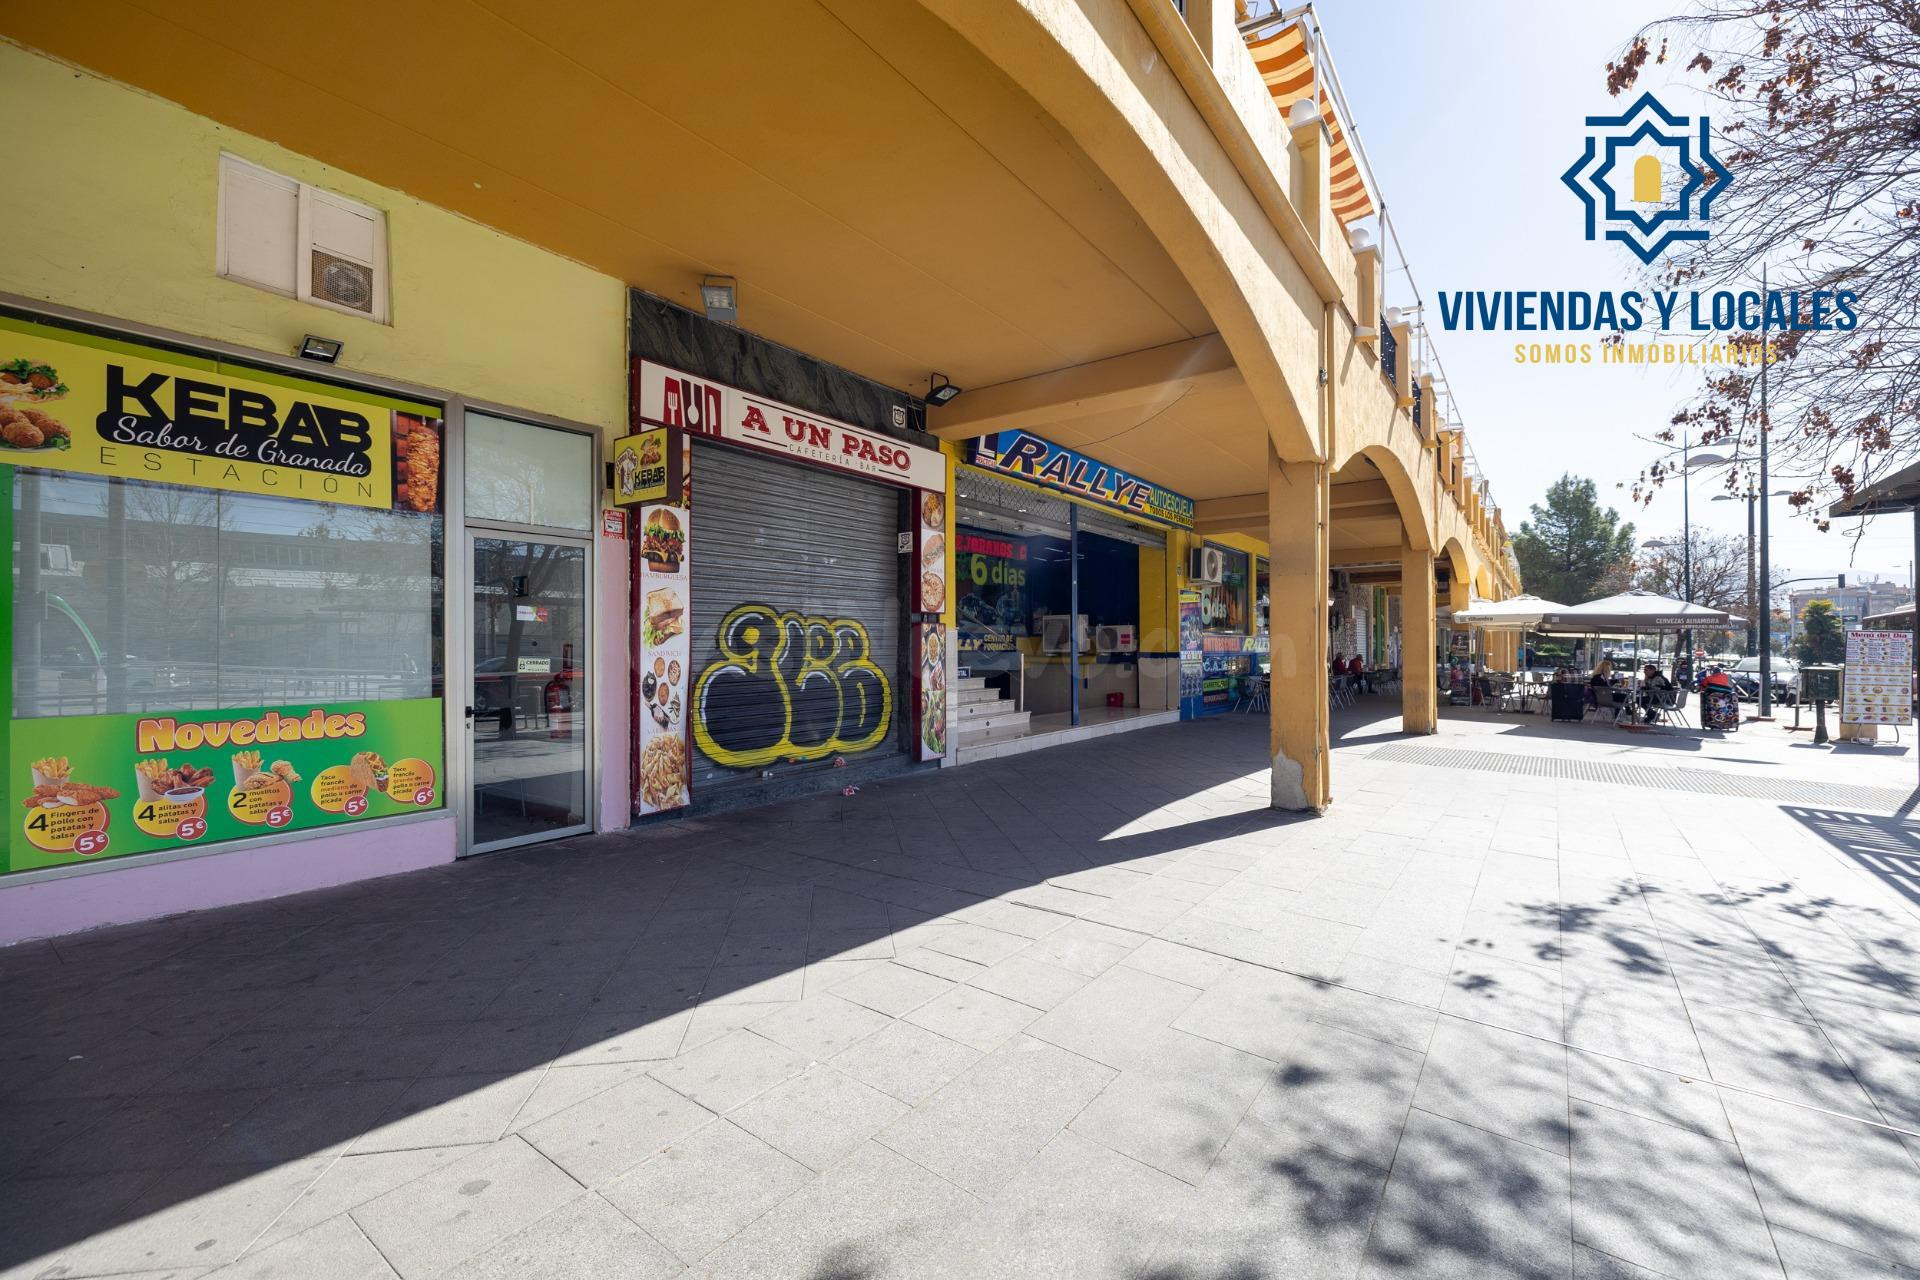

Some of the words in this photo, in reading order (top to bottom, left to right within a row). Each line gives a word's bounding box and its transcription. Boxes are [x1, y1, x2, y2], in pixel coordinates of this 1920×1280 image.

[107, 363, 372, 452] KEBAB
[113, 415, 207, 453] Sabor
[215, 433, 249, 458] de
[257, 438, 368, 476] Granada
[741, 405, 771, 435] A
[782, 415, 832, 451] UN
[842, 432, 911, 472] PASO
[100, 446, 372, 498] ESTACIÓN
[634, 466, 665, 485] KEBAB
[996, 433, 1152, 511] RALLYE
[1149, 487, 1194, 519] AUTOESCUELA
[971, 553, 988, 586] 6
[991, 560, 1026, 586] días
[136, 708, 367, 754] Novedades
[232, 792, 247, 808] 2
[416, 790, 433, 803] 6€
[50, 809, 86, 819] Fingers
[137, 804, 156, 822] 4
[158, 803, 182, 811] alitas
[158, 810, 189, 819] patatas
[347, 799, 366, 813] 5€
[28, 813, 49, 832] 4
[50, 818, 75, 827] pollo
[158, 817, 179, 825] salsa
[269, 809, 291, 823] 5€
[50, 824, 86, 834] patatas
[50, 832, 75, 841] salsa
[181, 821, 204, 837] 5€
[79, 833, 106, 851] 5€
